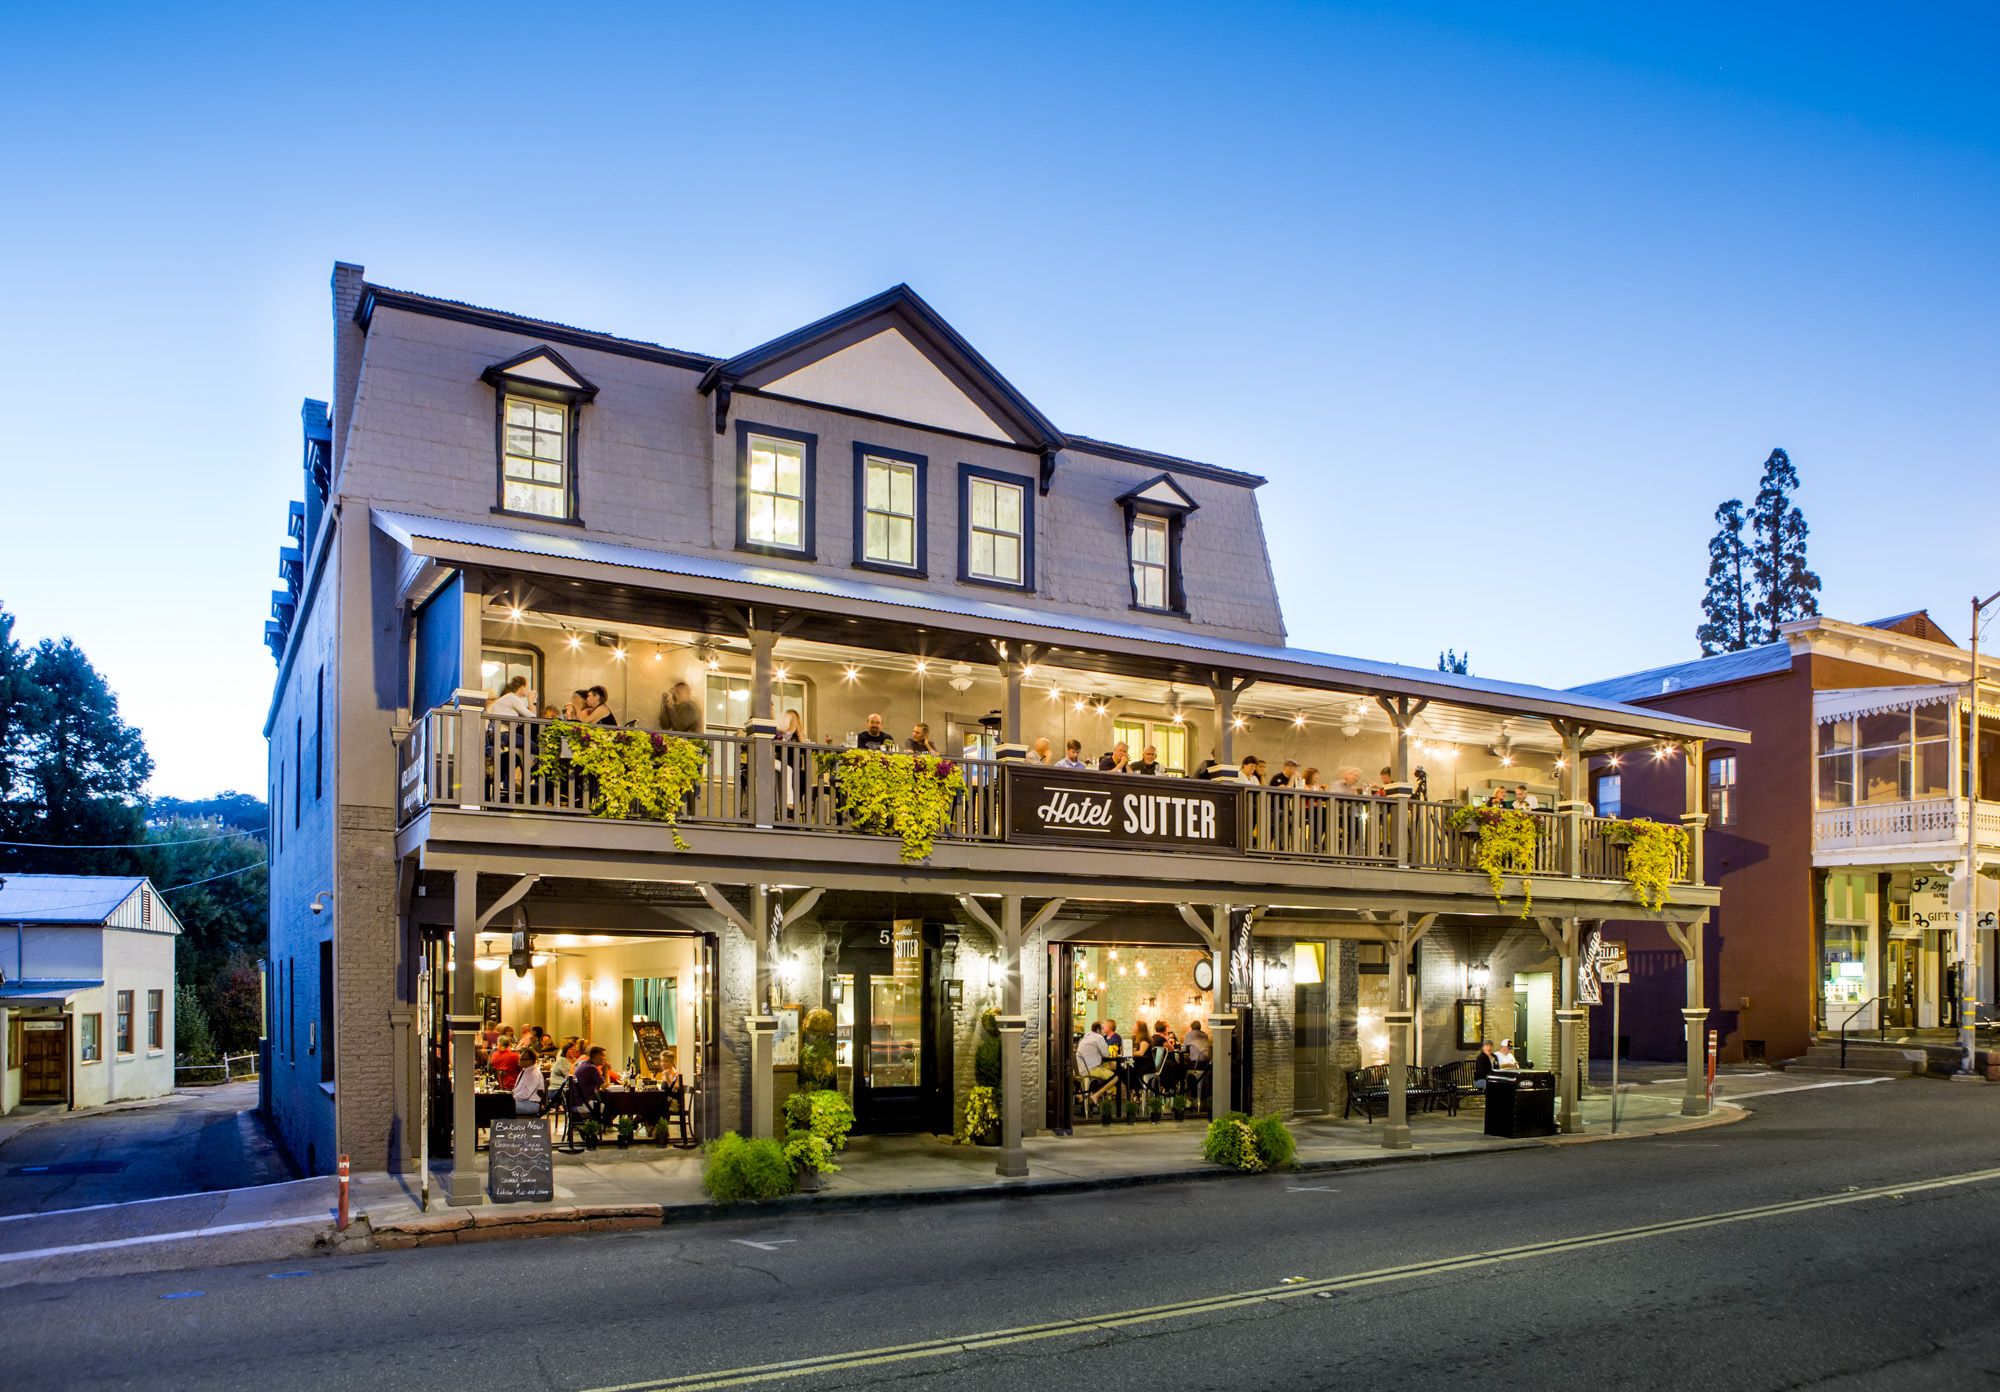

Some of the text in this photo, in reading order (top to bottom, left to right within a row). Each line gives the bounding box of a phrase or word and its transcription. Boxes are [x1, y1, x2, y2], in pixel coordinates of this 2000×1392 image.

[1037, 791, 1216, 839] Hotel SUTTER
[1928, 912, 1950, 921] GIFT
[895, 939, 919, 958] SUTTER
[1228, 912, 1253, 985] Welcome
[1600, 947, 1620, 959] ELLAR
[527, 1121, 544, 1130] Now
[507, 1132, 528, 1141] Open
